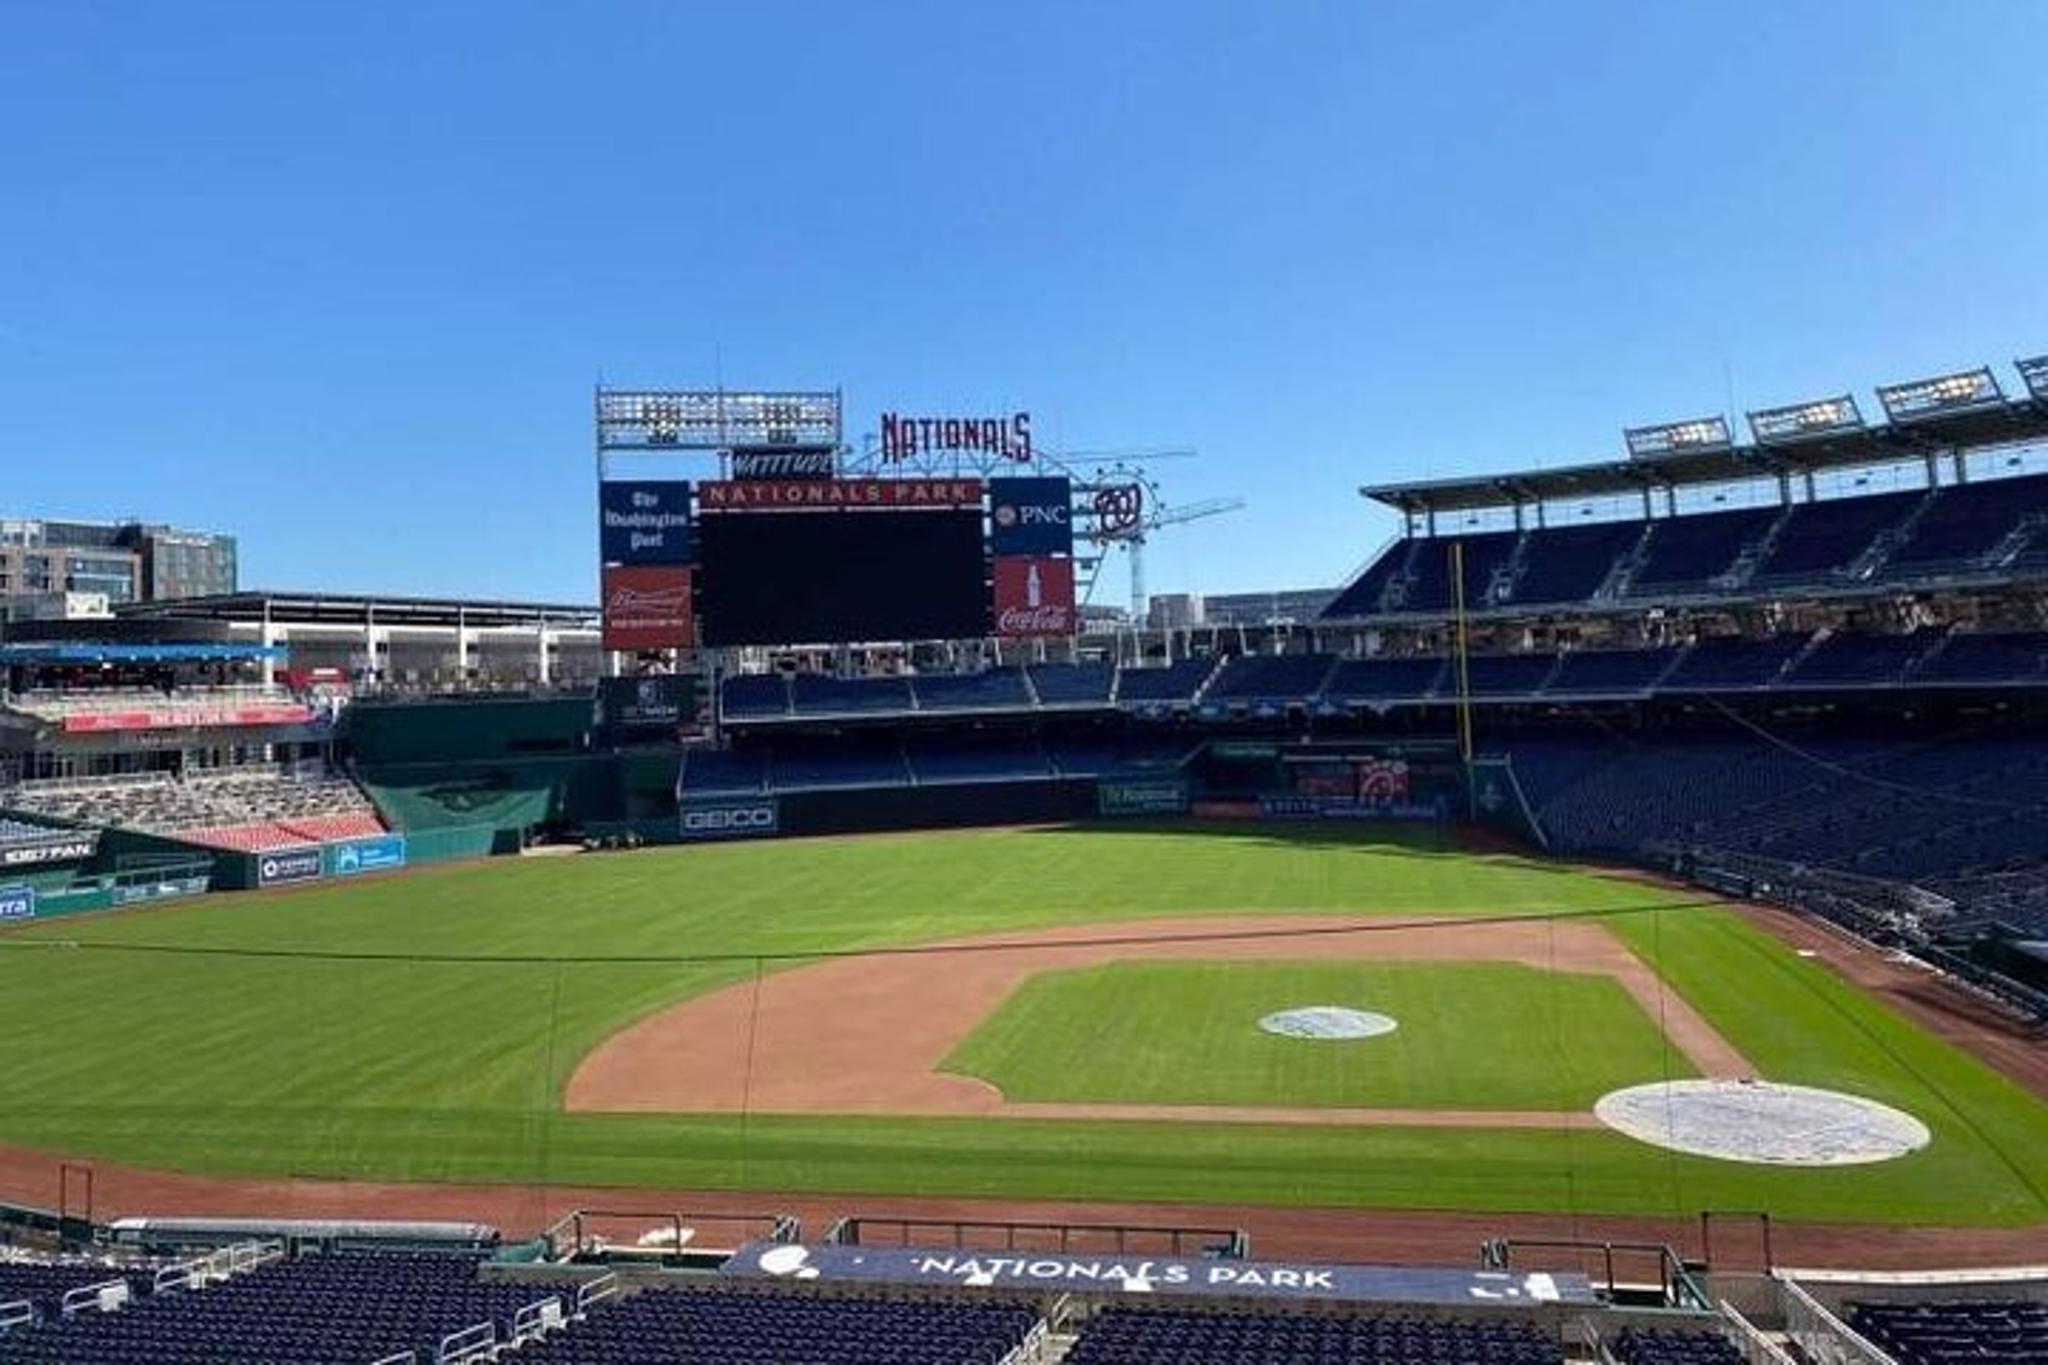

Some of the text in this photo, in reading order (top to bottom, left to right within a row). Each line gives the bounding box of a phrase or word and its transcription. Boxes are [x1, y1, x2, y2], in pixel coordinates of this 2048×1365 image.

[881, 412, 1031, 464] NATIONALS
[710, 483, 967, 502] NATIONALS PARK
[1020, 505, 1067, 525] PNC
[685, 809, 772, 828] GEICO
[921, 1257, 1333, 1289] NATIONALS PARK
